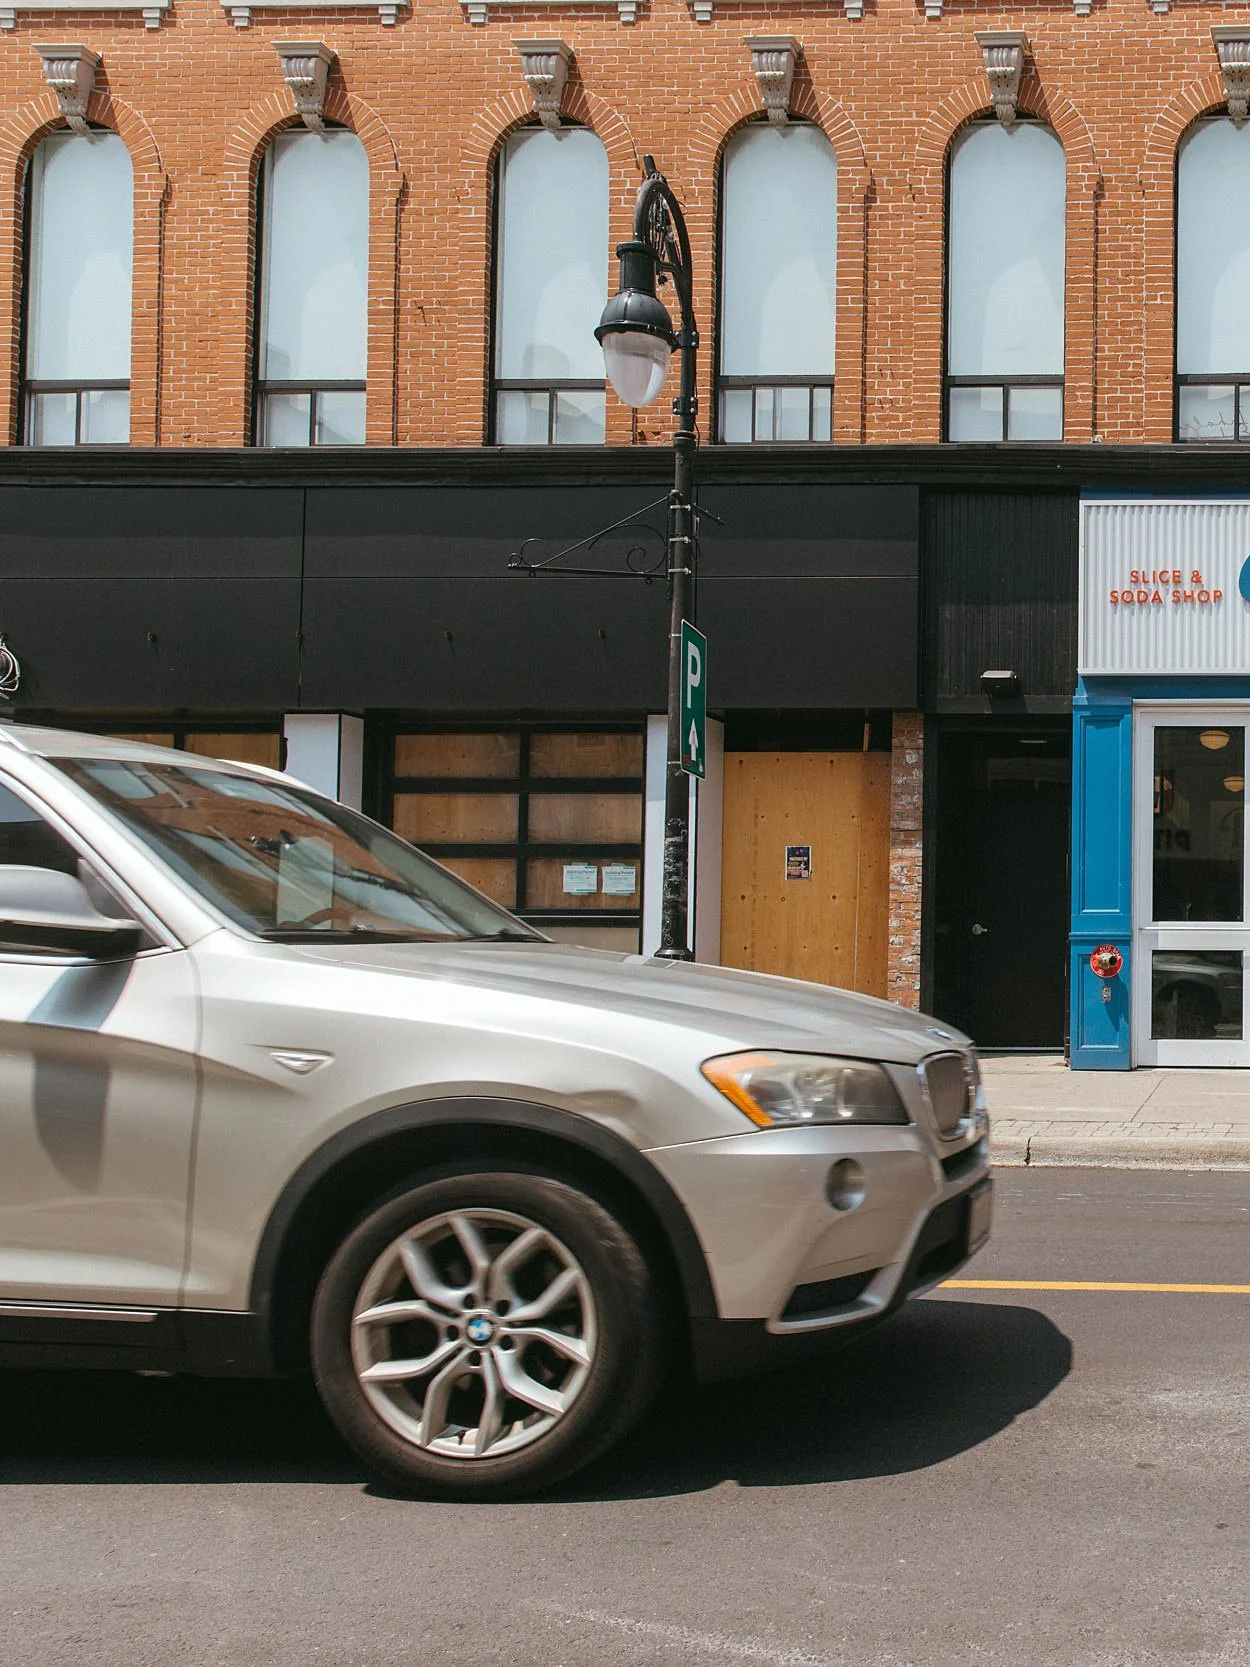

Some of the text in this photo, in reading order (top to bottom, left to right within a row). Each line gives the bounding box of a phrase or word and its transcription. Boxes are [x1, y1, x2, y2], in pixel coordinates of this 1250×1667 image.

[1130, 570, 1203, 584] SLICE &
[1110, 590, 1223, 604] SODA SHOP
[687, 640, 701, 709] P
